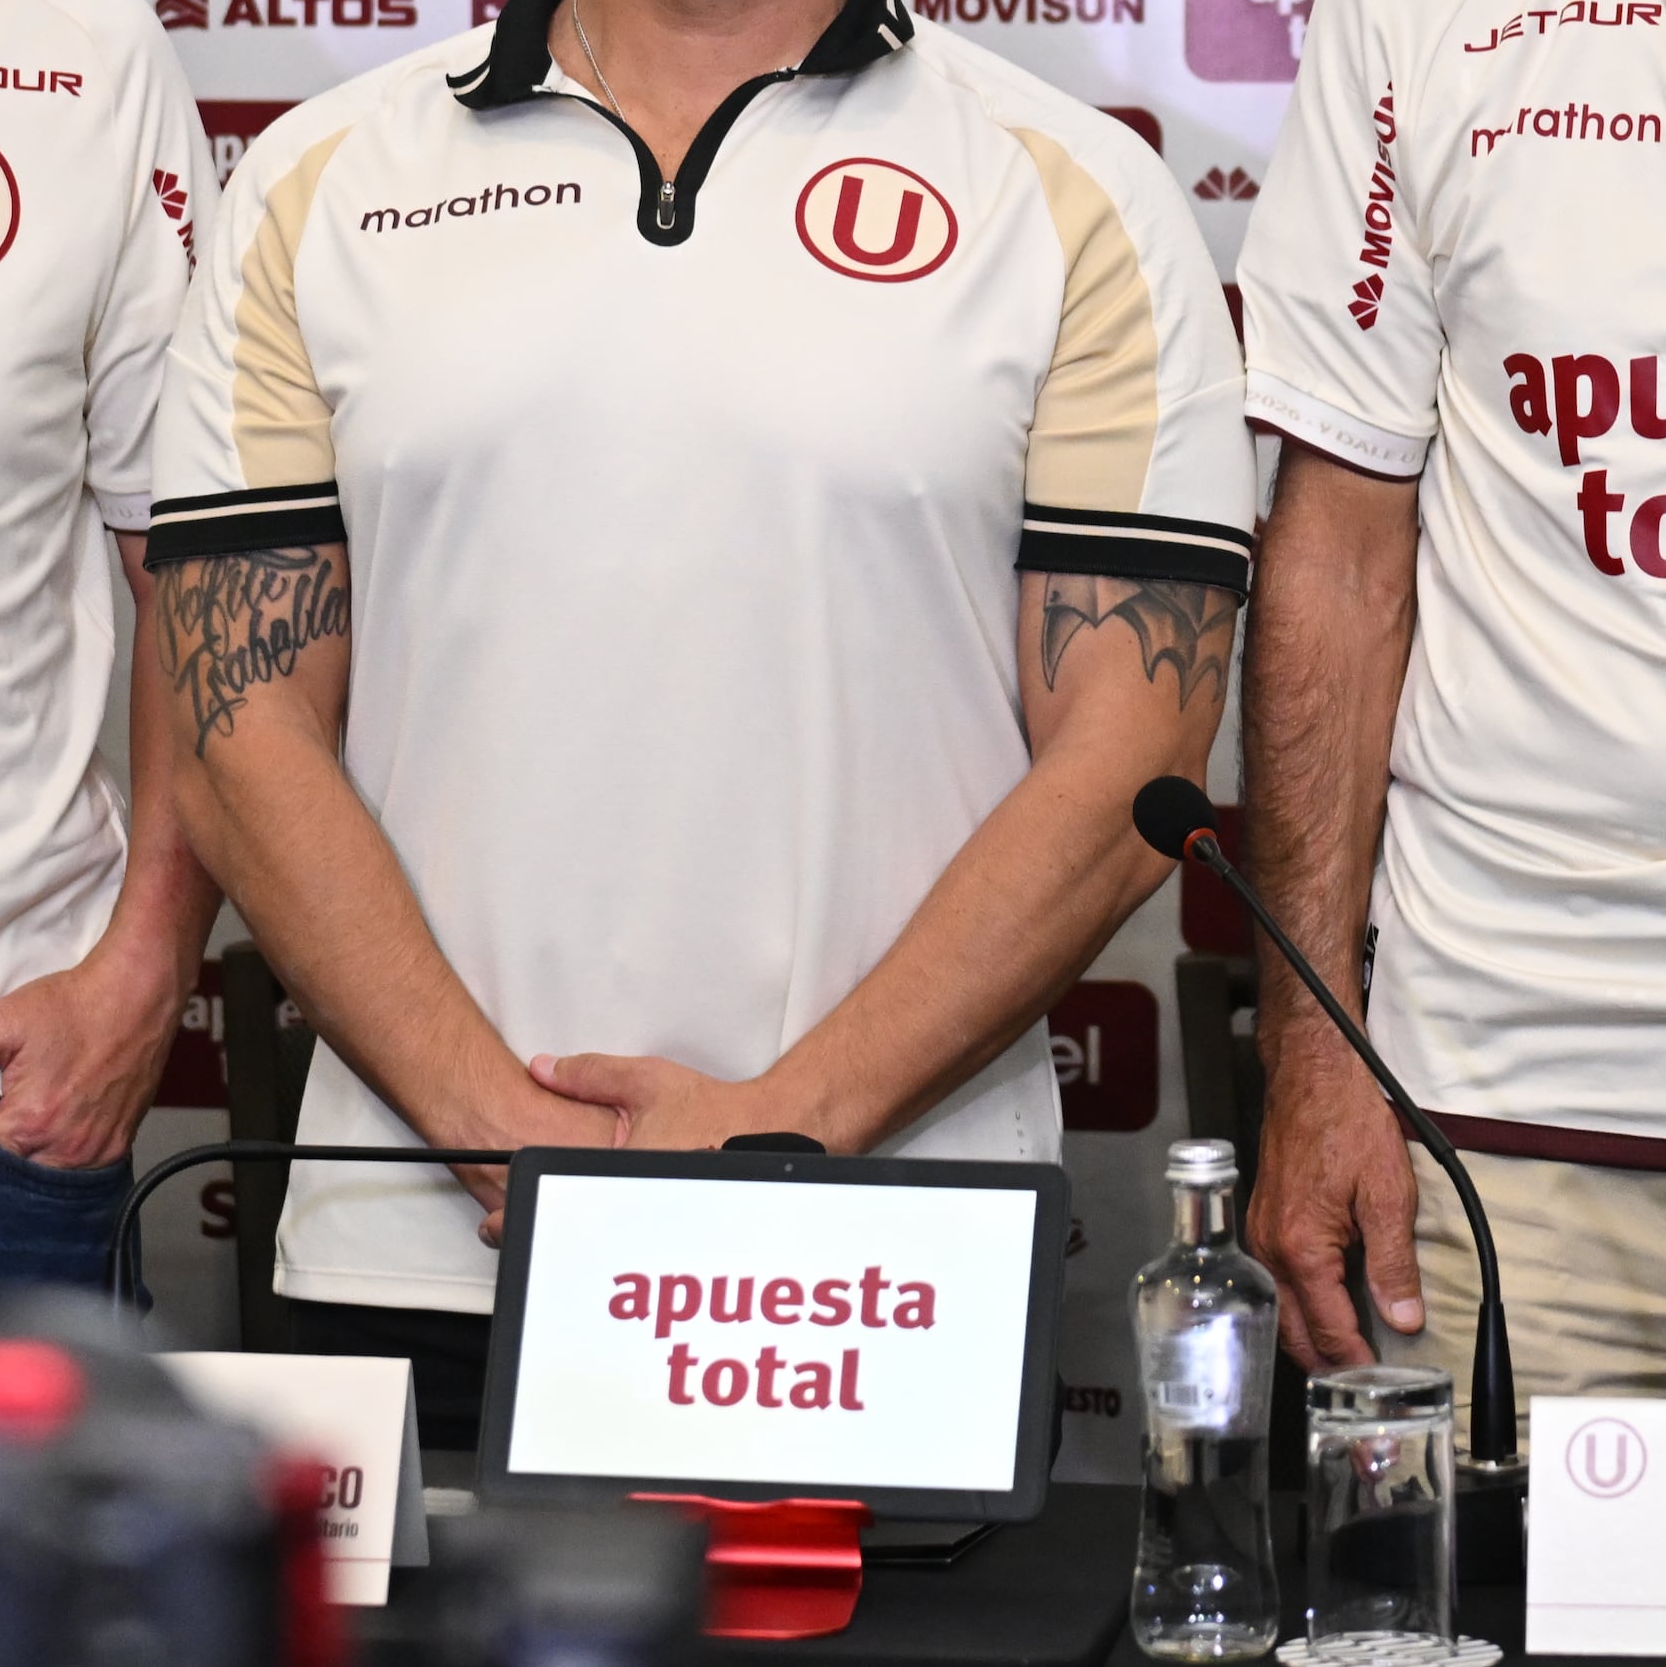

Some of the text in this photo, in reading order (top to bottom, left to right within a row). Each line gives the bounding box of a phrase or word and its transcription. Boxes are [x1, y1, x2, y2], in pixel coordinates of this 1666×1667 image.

[1464, 0, 1663, 53] JETOUR
[1471, 101, 1663, 157] mrathon
[1359, 80, 1398, 269] MOVISU
[360, 181, 582, 234] marathon
[832, 175, 924, 266] U
[608, 1266, 937, 1339] apuesta
[667, 1341, 865, 1412] total
[1585, 1433, 1628, 1489] U
